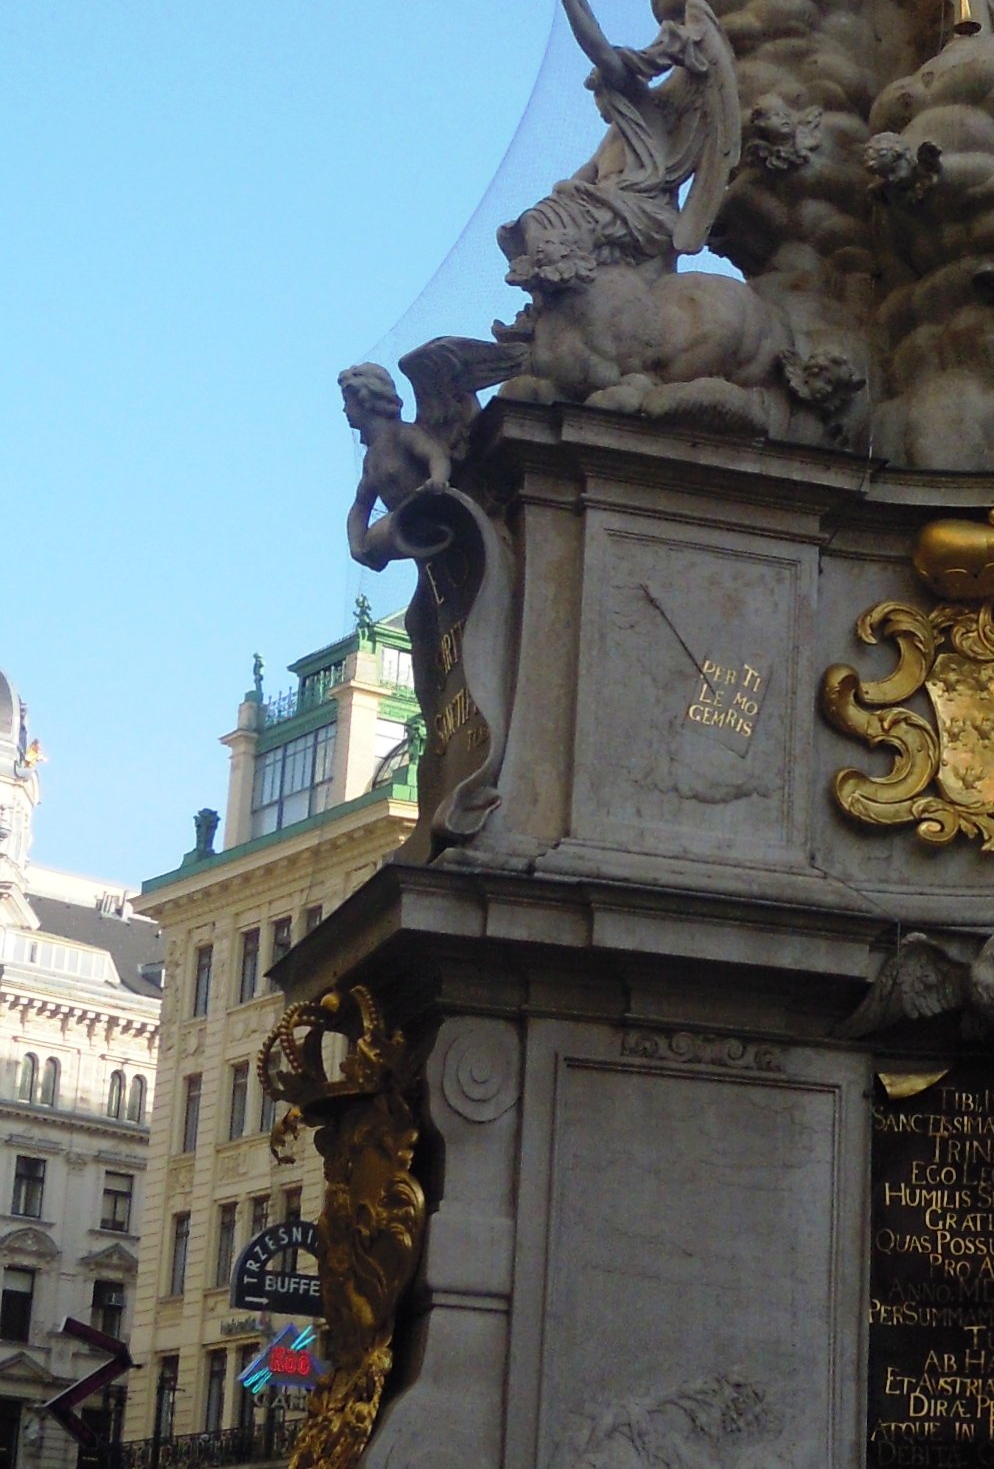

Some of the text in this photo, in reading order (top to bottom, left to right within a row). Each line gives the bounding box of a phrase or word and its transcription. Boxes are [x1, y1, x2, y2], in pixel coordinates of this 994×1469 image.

[701, 659, 737, 685] PER
[885, 1182, 972, 1209] HUMILIS
[244, 1226, 319, 1284] TRZESNI
[875, 1228, 931, 1255] QUAS
[264, 1275, 321, 1297] BUFFE
